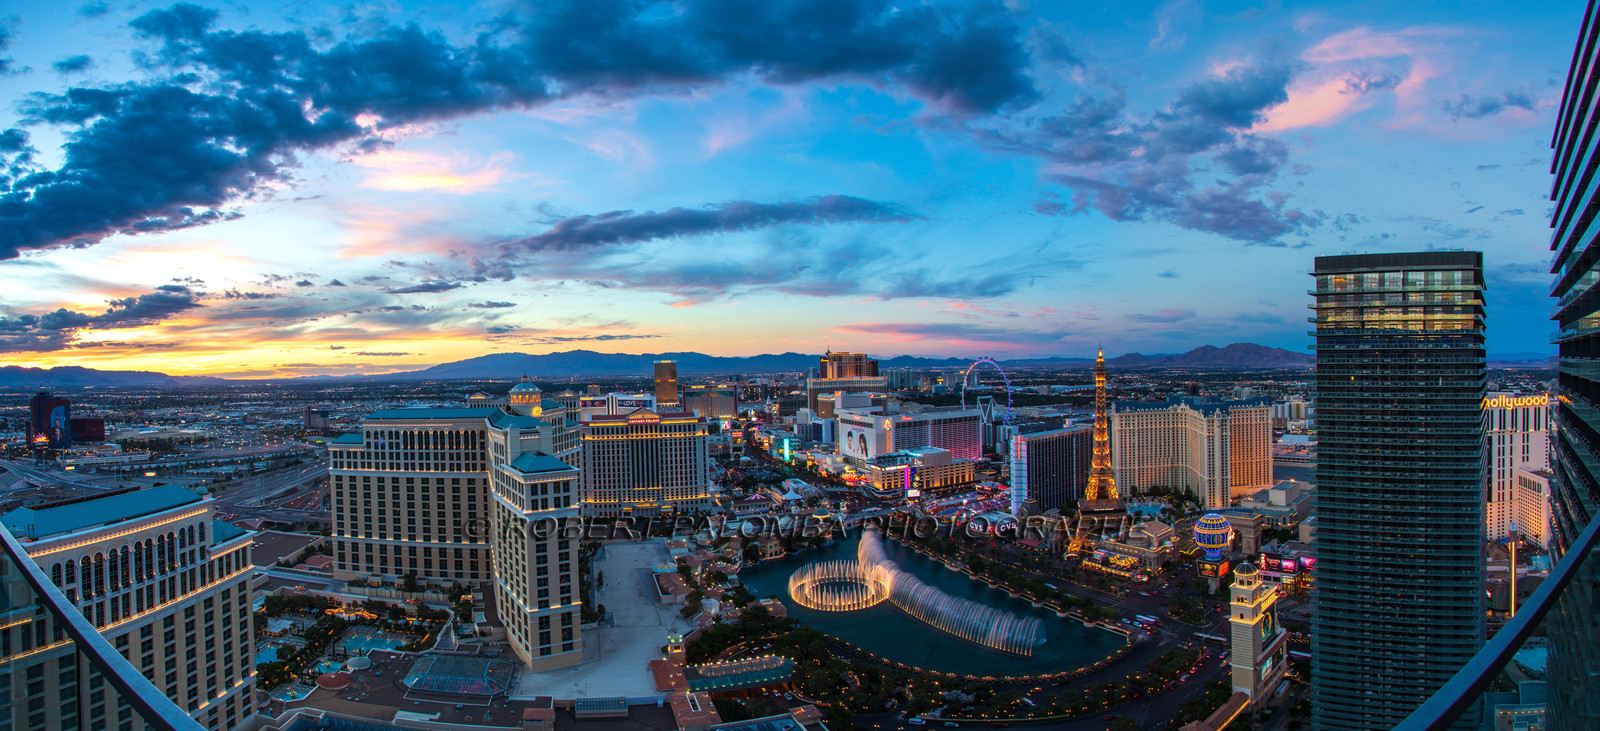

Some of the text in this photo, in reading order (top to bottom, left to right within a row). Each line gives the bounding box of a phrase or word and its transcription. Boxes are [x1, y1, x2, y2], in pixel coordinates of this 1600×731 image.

[1481, 393, 1549, 411] hollywood
[969, 522, 984, 532] CVS
[1000, 522, 1017, 532] CVS
